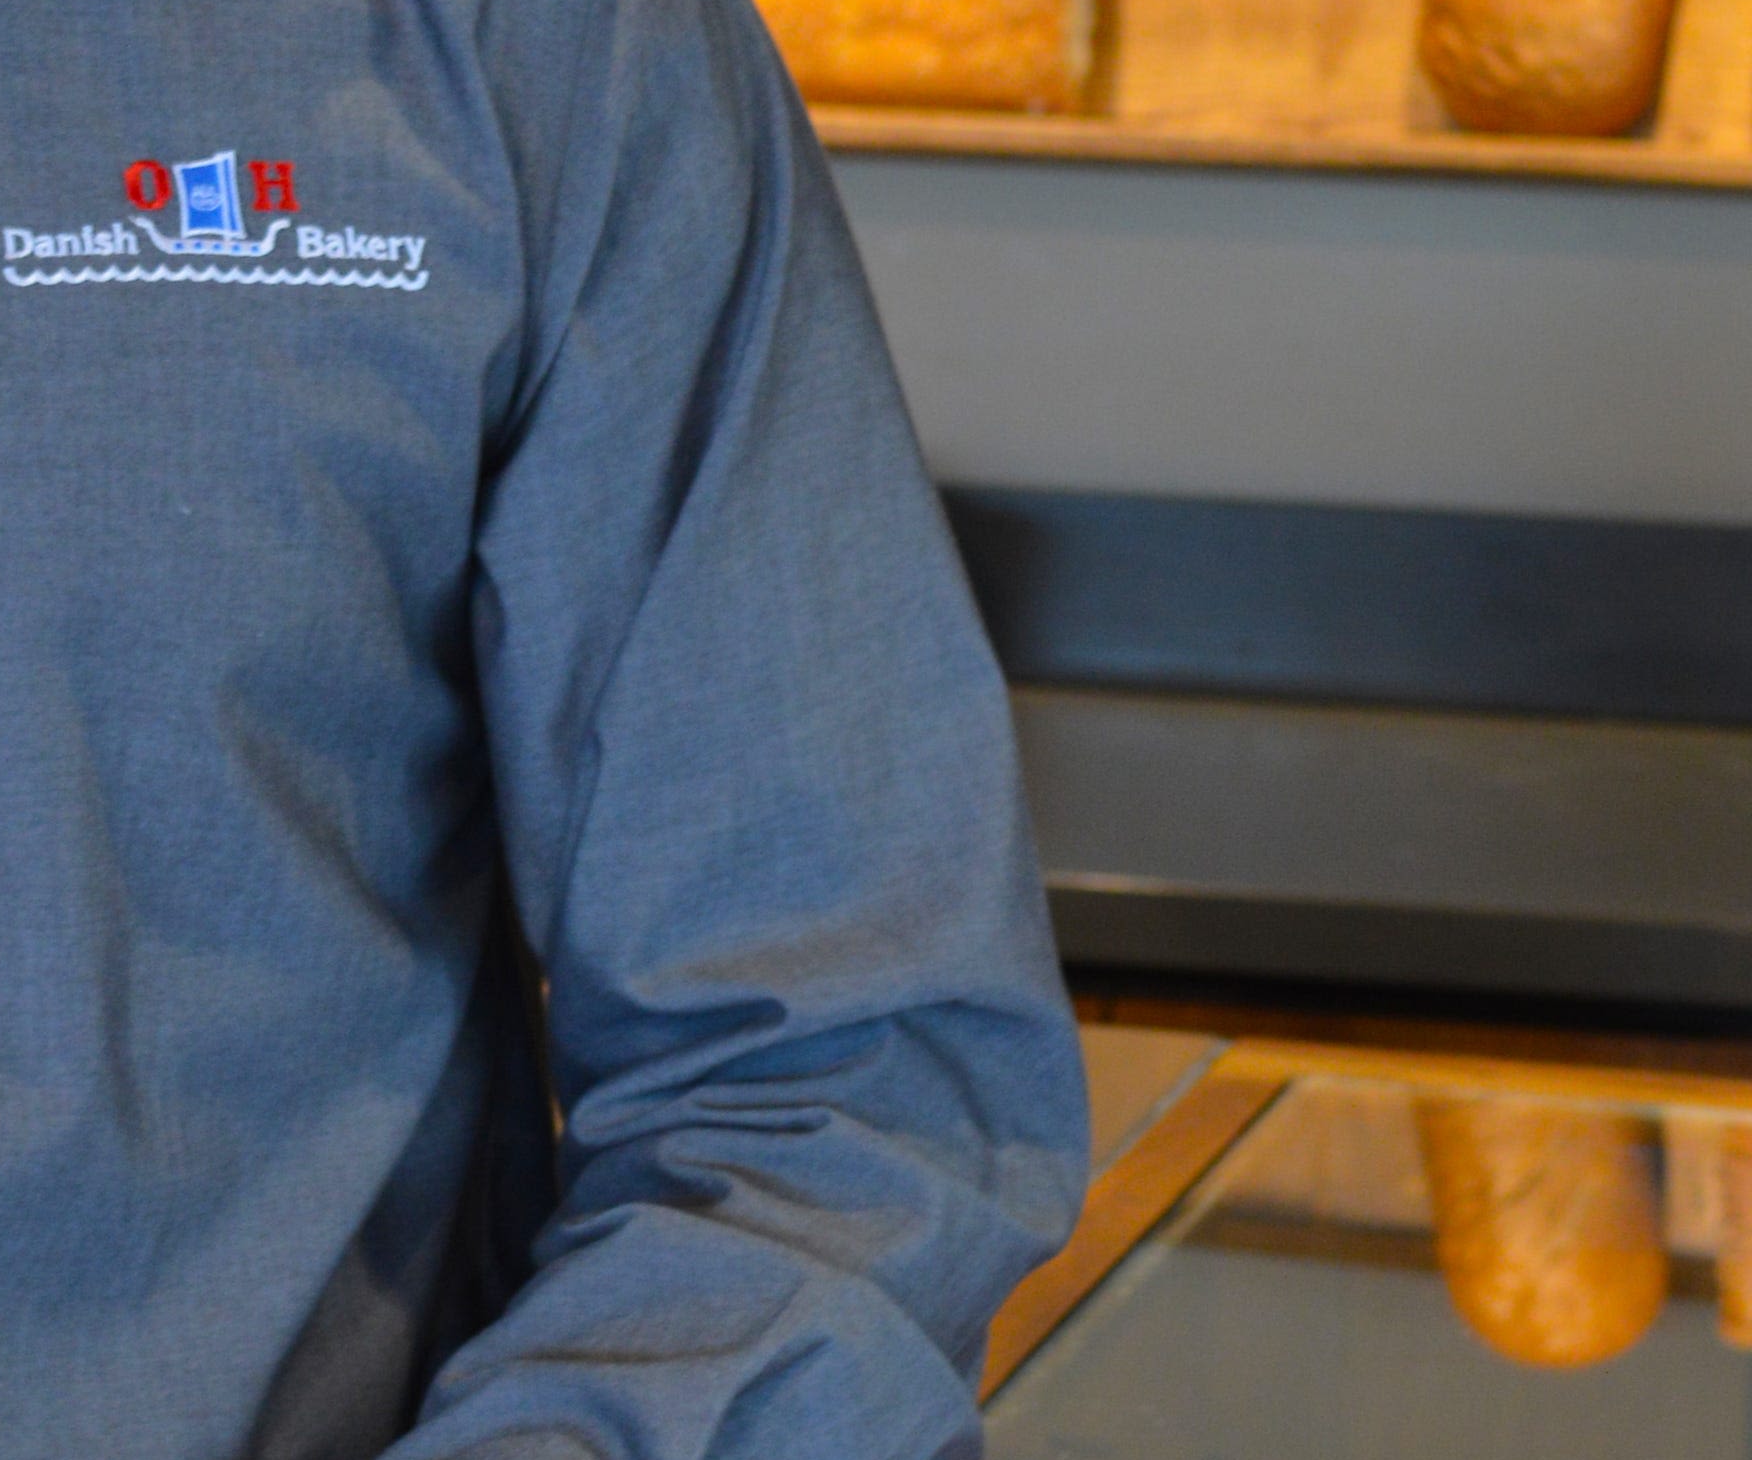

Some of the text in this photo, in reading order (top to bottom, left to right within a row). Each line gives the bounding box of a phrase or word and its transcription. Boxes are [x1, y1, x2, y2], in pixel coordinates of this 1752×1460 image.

[124, 160, 301, 211] O H
[3, 223, 425, 270] Danish Bakery
